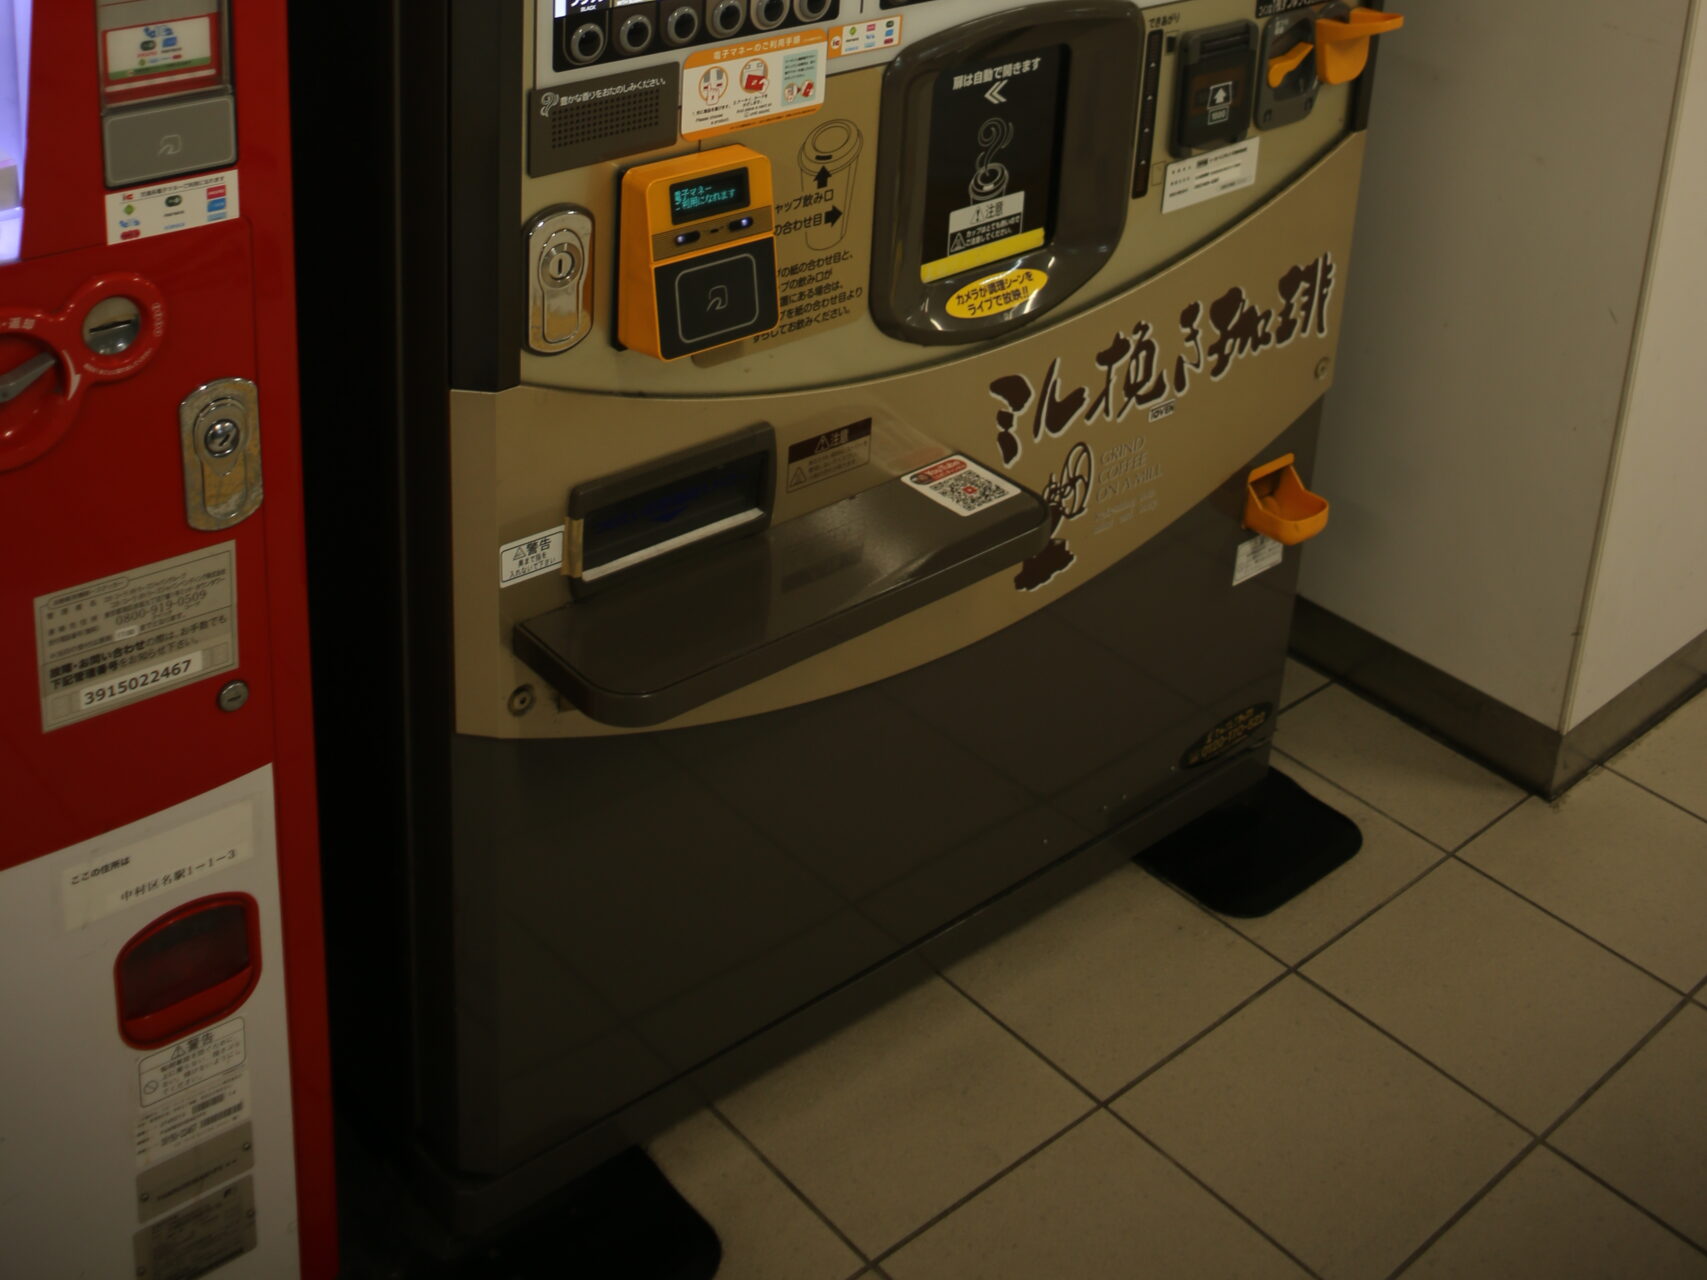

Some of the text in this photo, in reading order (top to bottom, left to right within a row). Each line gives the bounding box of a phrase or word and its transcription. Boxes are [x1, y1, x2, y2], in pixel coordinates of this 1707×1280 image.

[953, 58, 1041, 90] 扉は自動で開きます
[674, 185, 712, 199] 電子マネー
[777, 250, 853, 277] の紙の合わせ目と、
[956, 271, 1034, 305] カメラが調理シーンを
[1101, 436, 1145, 466] GRIND
[1098, 453, 1147, 484] COFFEE
[526, 536, 552, 556] 警告
[85, 659, 192, 705] 3915022467
[71, 856, 130, 885] ここの住所は
